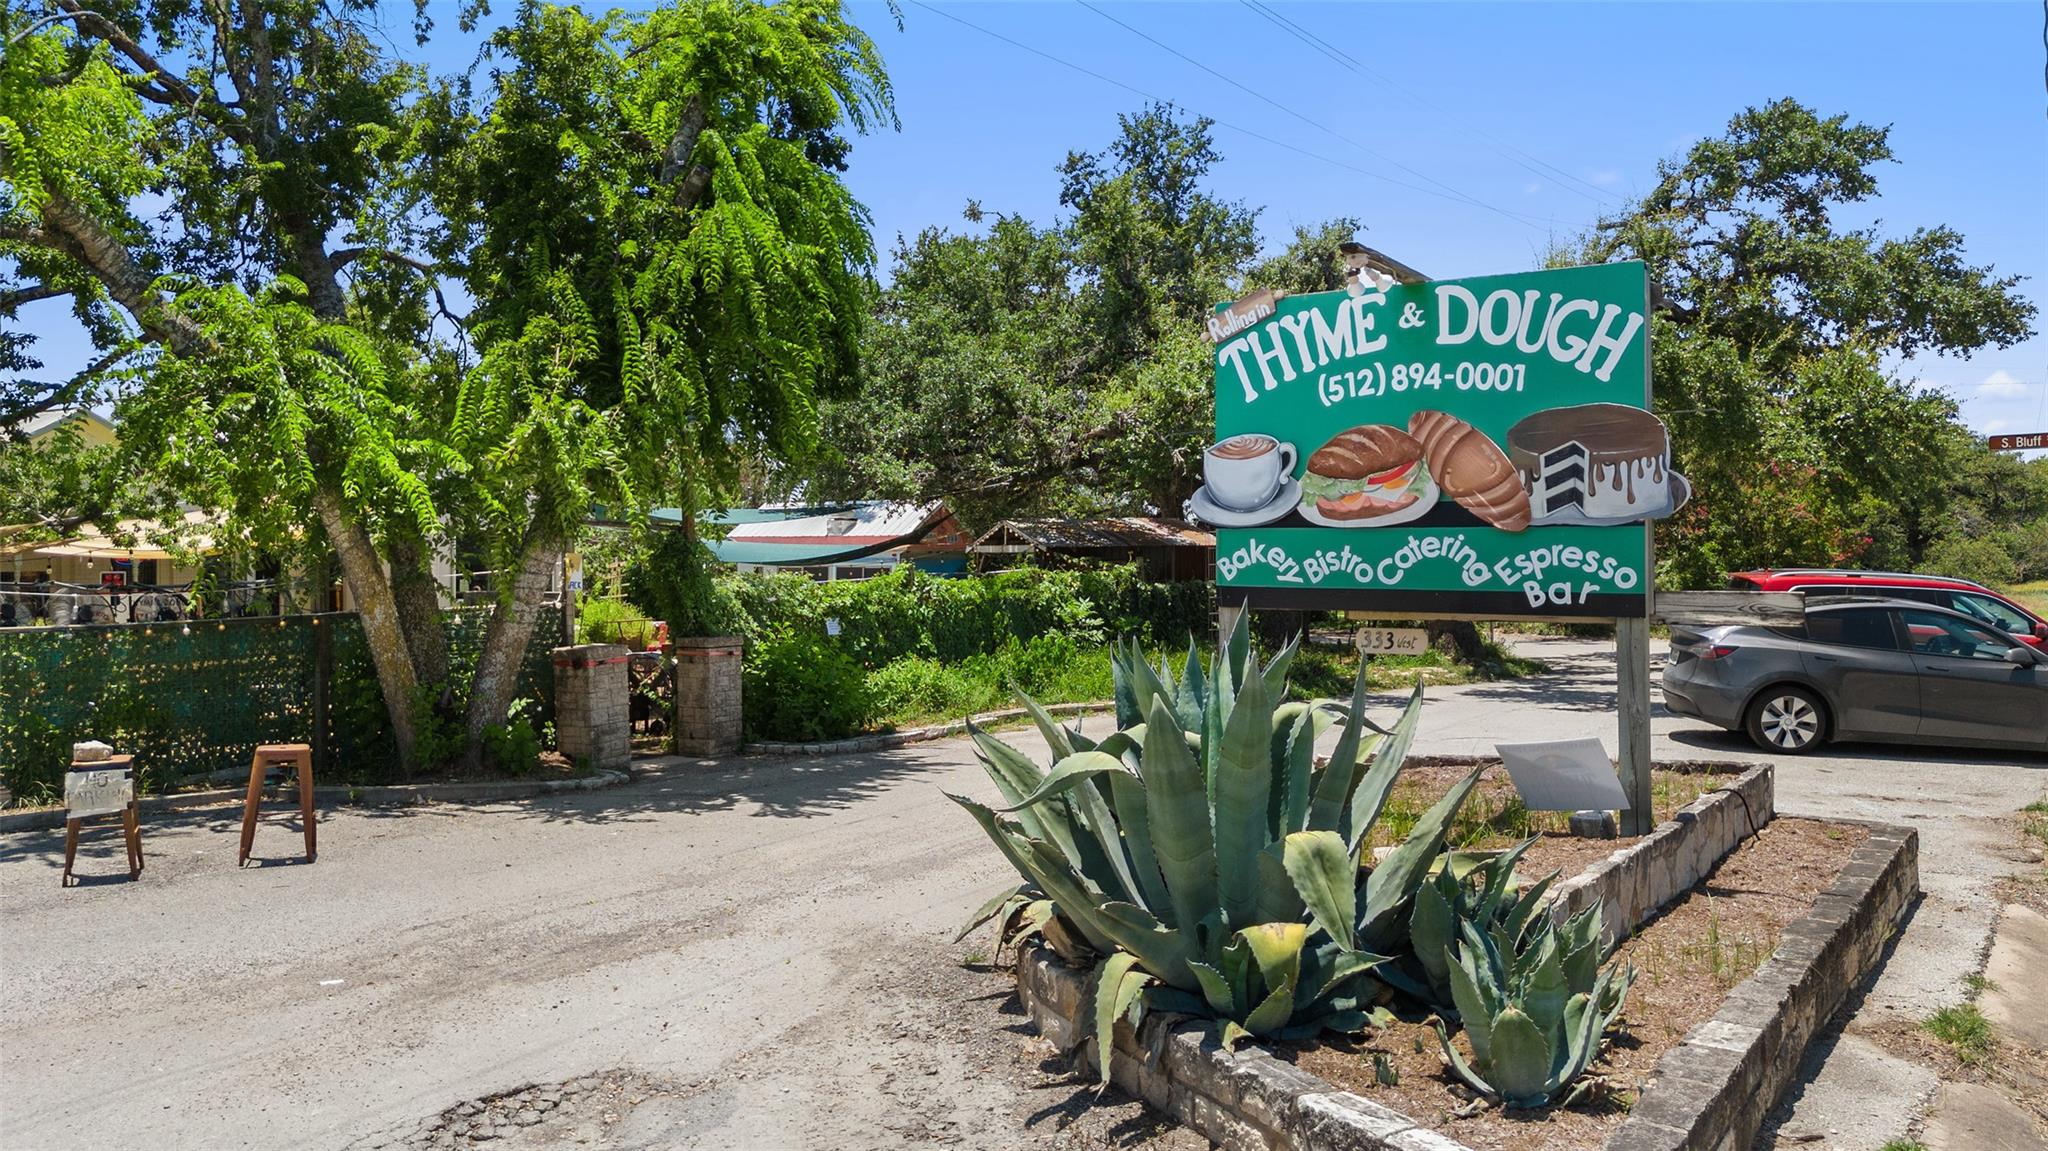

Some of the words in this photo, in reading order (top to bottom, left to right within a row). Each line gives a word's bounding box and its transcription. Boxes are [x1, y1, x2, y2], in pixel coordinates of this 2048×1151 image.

[1207, 309, 1257, 342] Rolling
[1218, 293, 1387, 404] THYME
[1398, 302, 1425, 329] &
[1434, 285, 1644, 382] DOUGH
[1317, 362, 1386, 406] (512)
[1391, 362, 1526, 392] 894-0001
[2001, 437, 2012, 449] S.
[2016, 435, 2042, 448] Bluff
[1216, 538, 1304, 584] Bakery
[1303, 545, 1374, 584] Bistro
[1376, 533, 1493, 587] Catering
[1494, 543, 1638, 589] Espresso
[1523, 580, 1601, 608] Bar
[1361, 630, 1395, 650] 333
